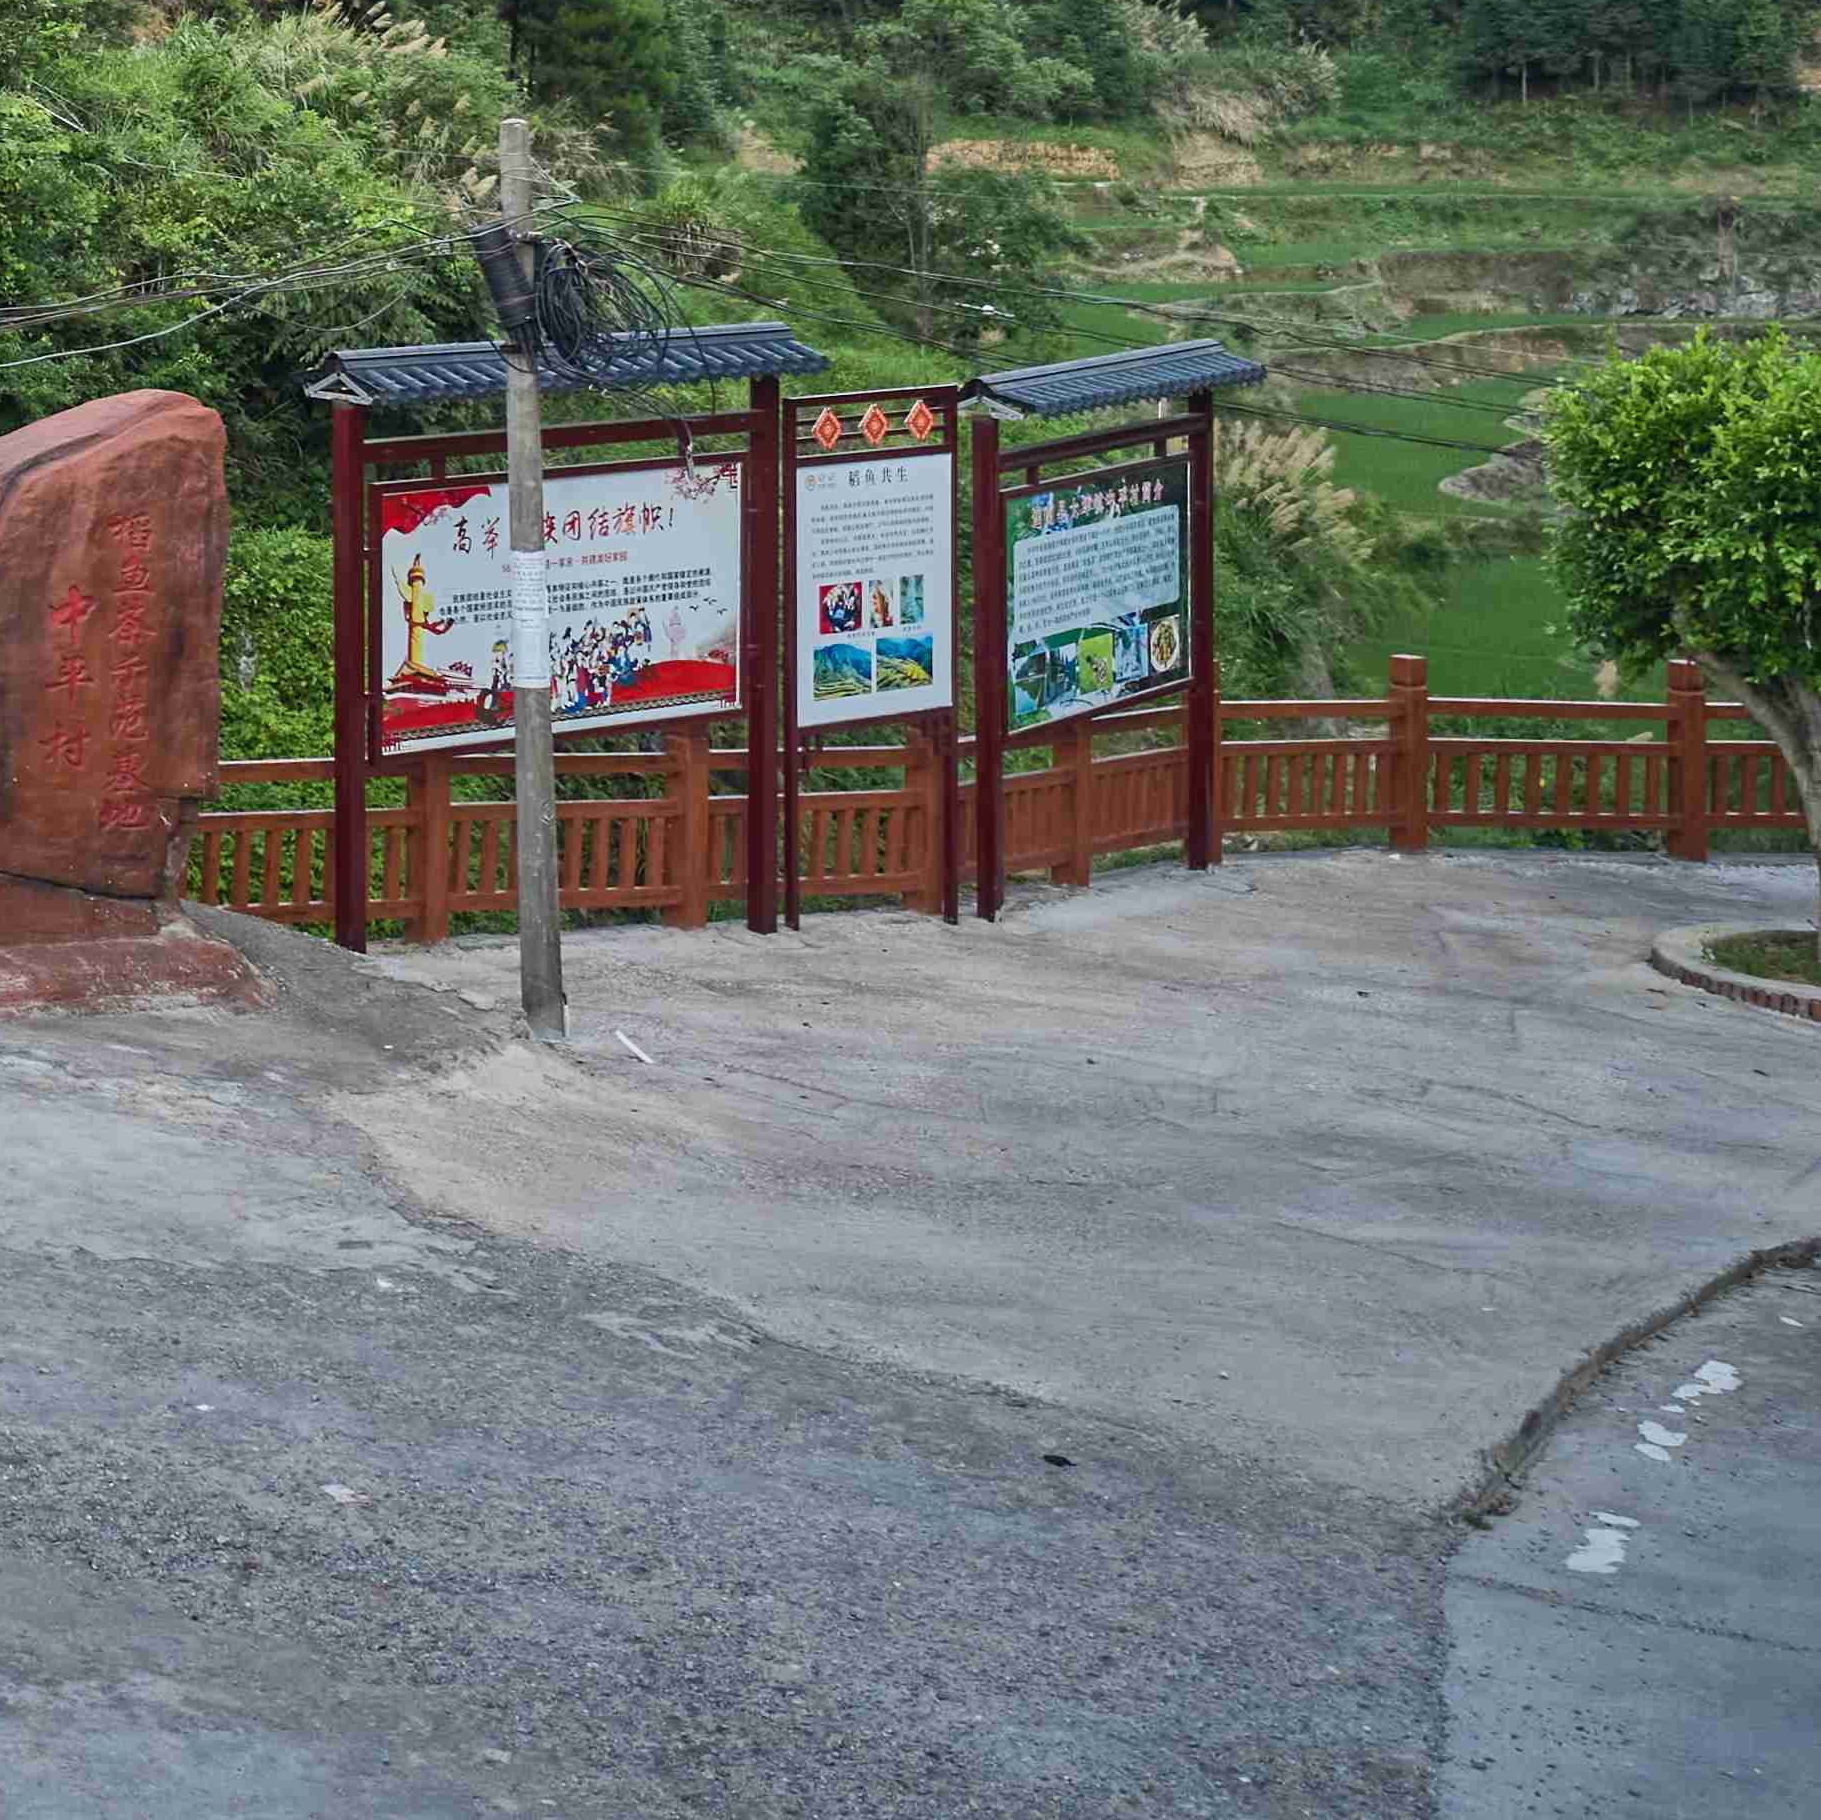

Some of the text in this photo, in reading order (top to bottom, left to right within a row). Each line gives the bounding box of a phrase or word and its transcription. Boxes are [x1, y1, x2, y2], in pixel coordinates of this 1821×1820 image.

[848, 466, 909, 487] 稻鱼共生
[37, 584, 97, 768] 中平村
